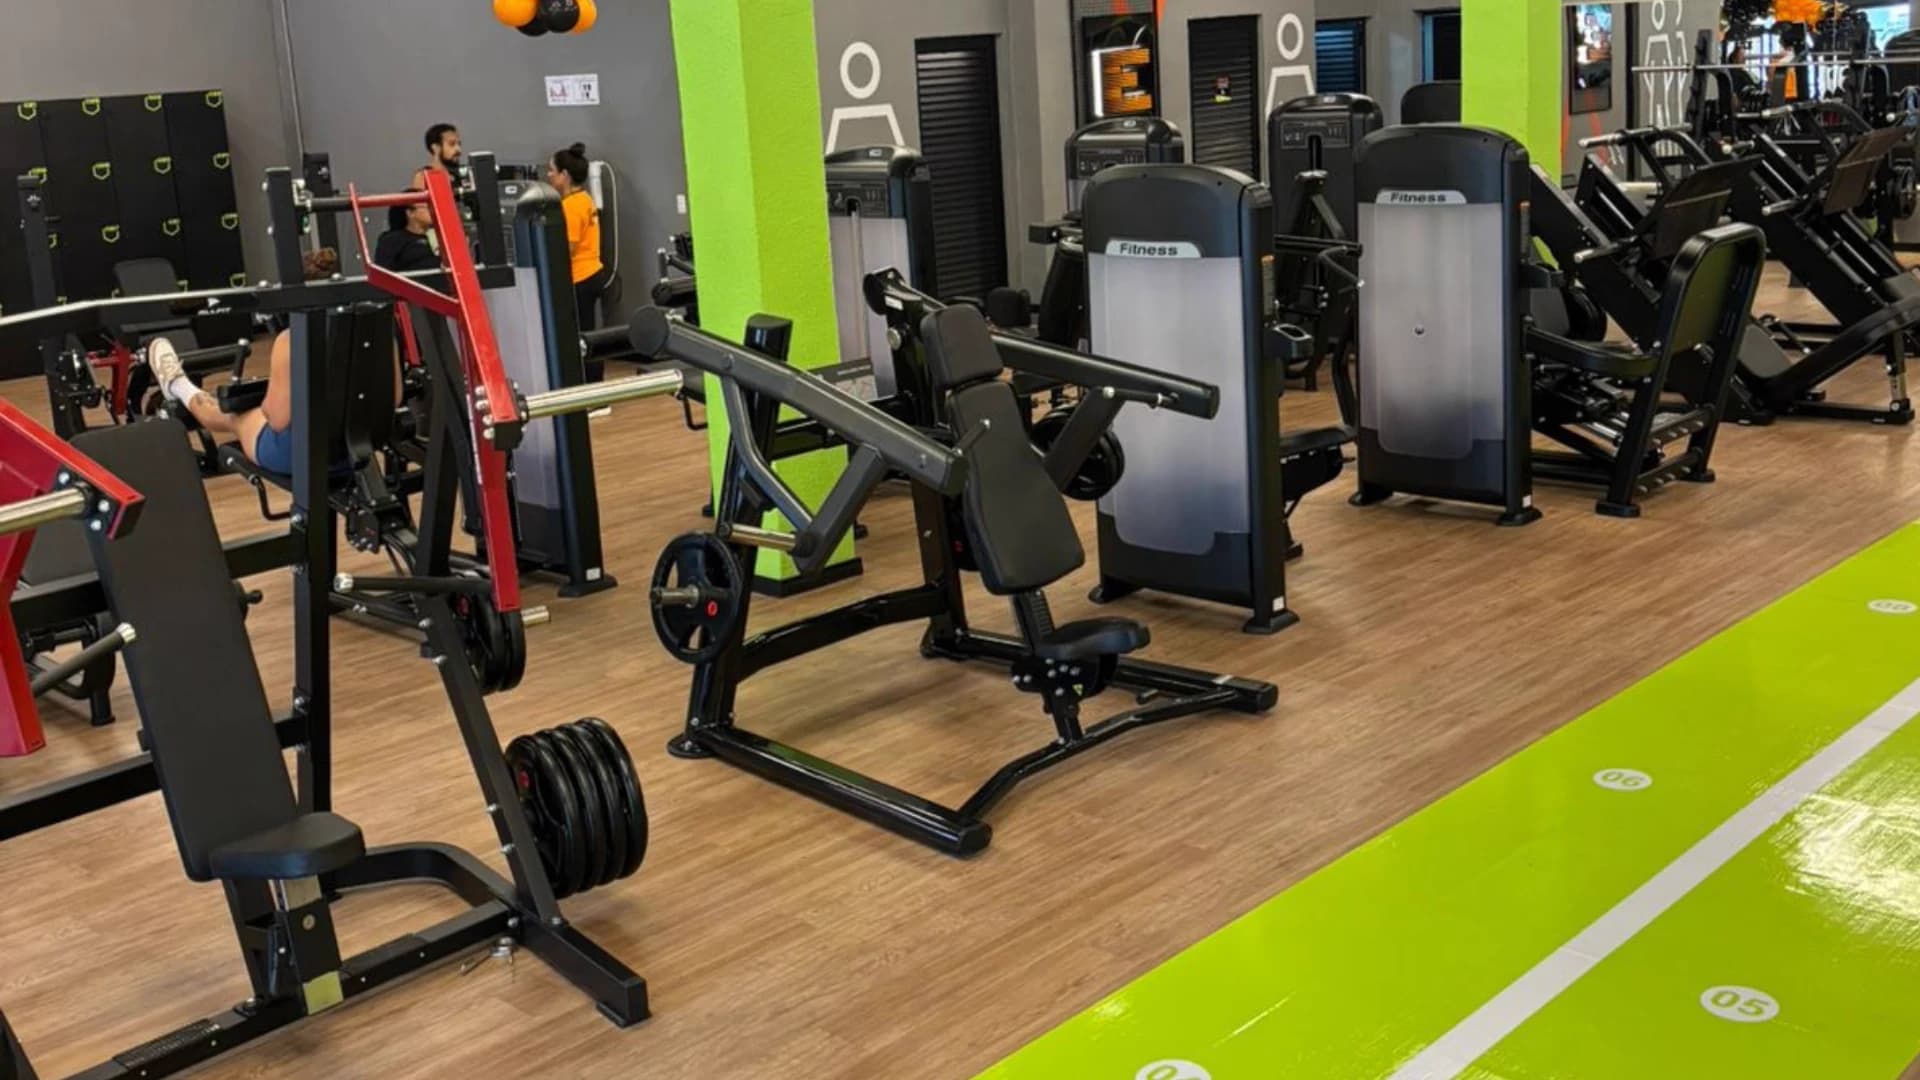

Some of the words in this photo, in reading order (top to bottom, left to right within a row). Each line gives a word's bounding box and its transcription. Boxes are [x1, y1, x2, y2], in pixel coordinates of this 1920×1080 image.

[1390, 191, 1446, 203] Fitness
[1120, 242, 1178, 256] Fitness
[1711, 990, 1769, 1015] 05
[1146, 1065, 1203, 1080] 0
